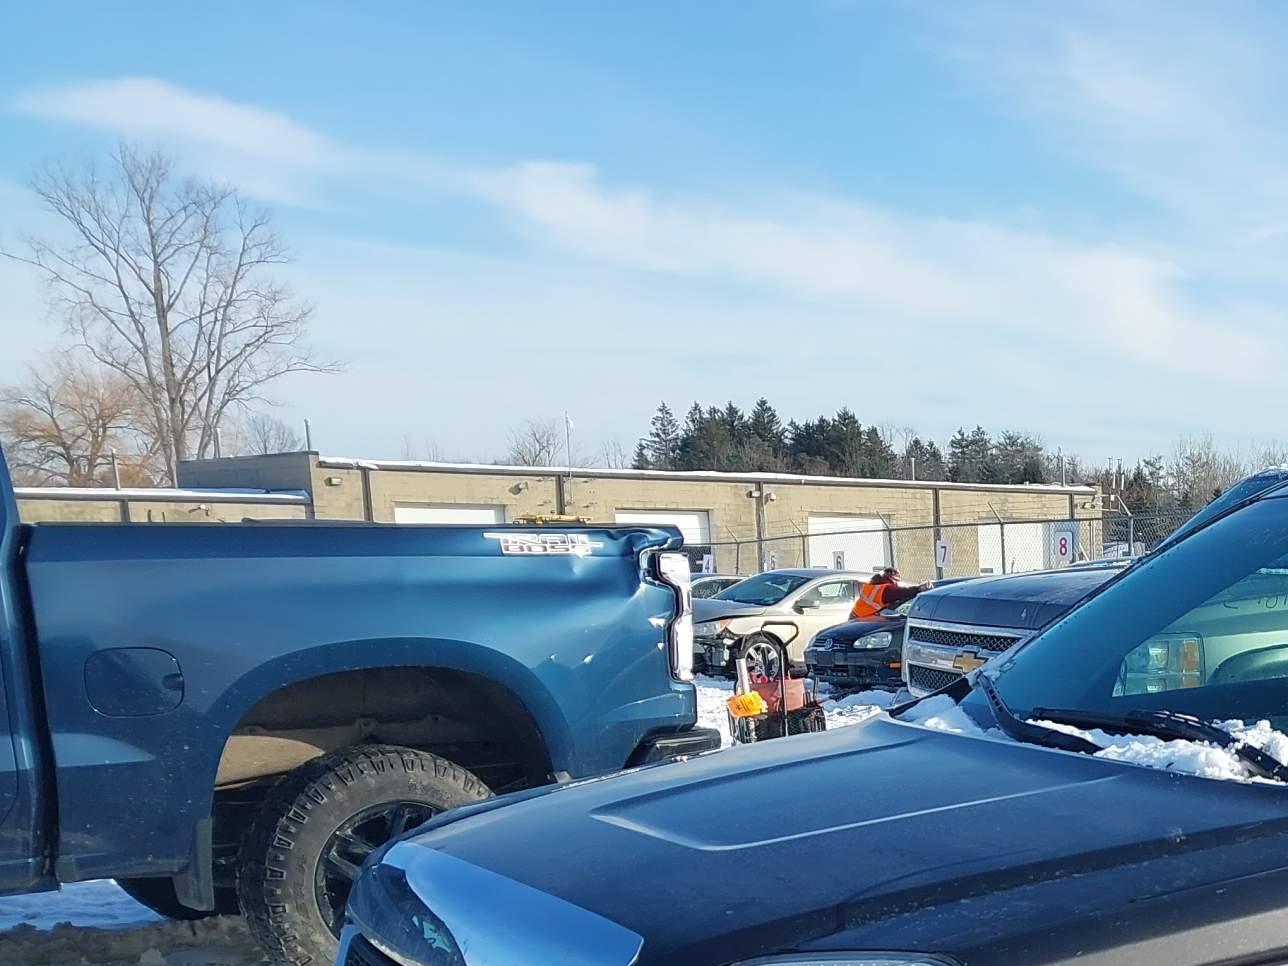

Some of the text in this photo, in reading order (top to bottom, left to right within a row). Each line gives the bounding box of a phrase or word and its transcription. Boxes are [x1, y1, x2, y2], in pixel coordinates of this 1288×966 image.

[940, 545, 947, 563] 7
[1059, 537, 1067, 556] 8
[704, 558, 711, 573] 4
[836, 555, 842, 570] 6
